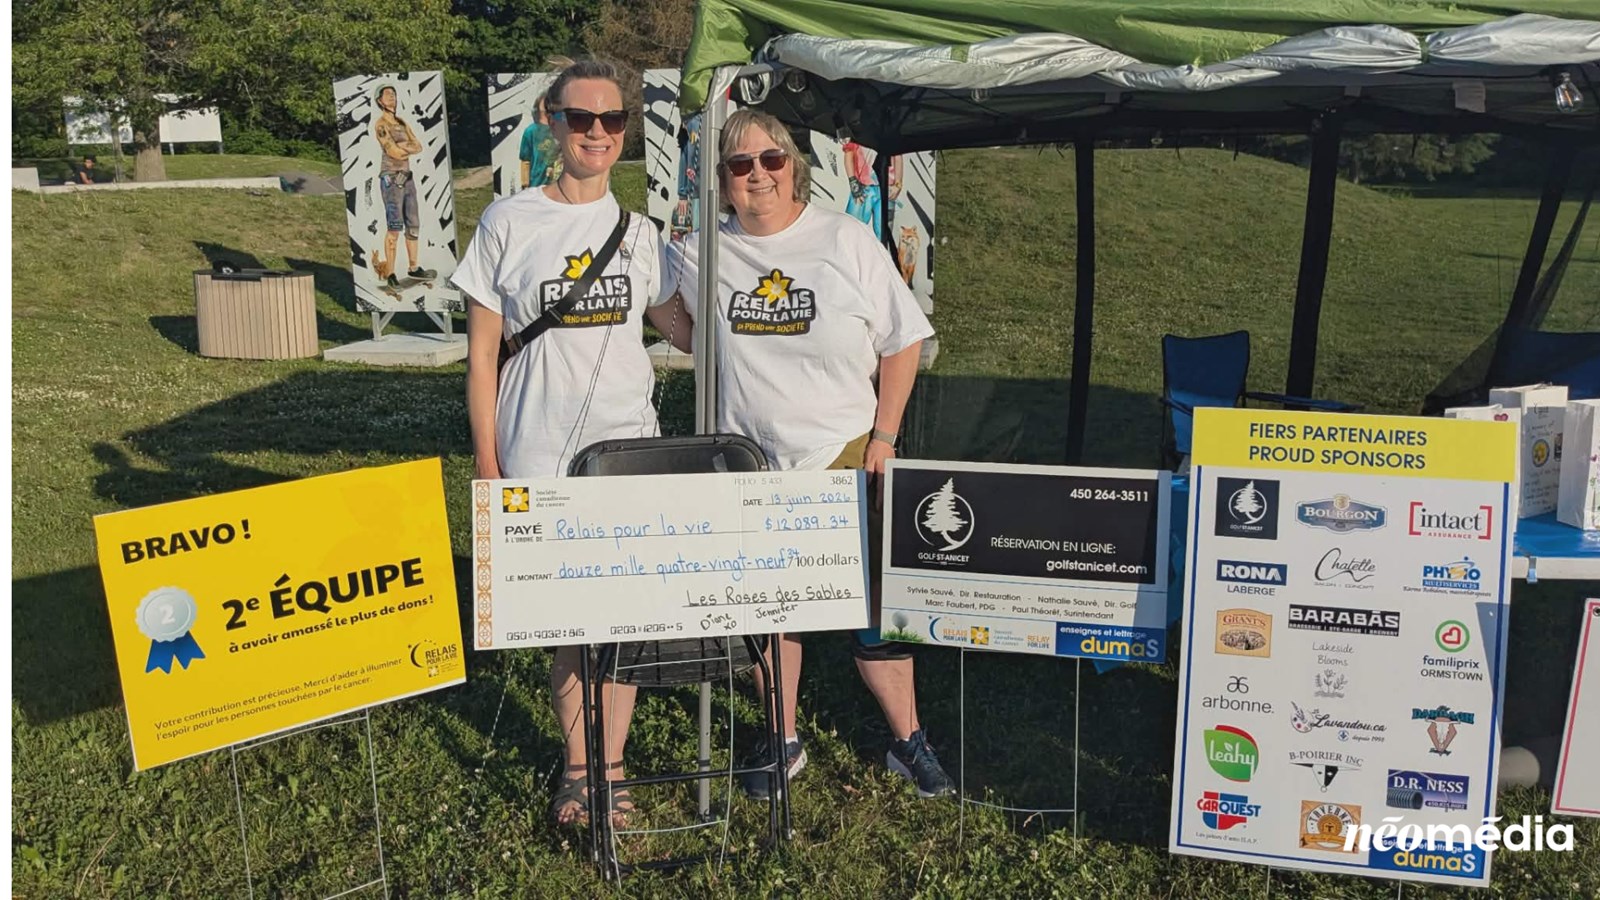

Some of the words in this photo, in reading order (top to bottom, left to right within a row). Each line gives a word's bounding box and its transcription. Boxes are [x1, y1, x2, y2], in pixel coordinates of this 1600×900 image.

[544, 277, 628, 302] REAIS
[733, 291, 811, 312] RELAIS
[732, 310, 770, 321] POUR
[773, 311, 789, 321] LA
[790, 309, 812, 319] VIE
[1250, 423, 1296, 439] FIERS
[1303, 426, 1427, 446] PARTENAIRES
[1250, 446, 1315, 463] PROUD
[1321, 450, 1426, 469] SPONSORS
[830, 476, 853, 485] 3862
[770, 494, 781, 504] 13
[786, 492, 812, 513] juin
[1070, 488, 1092, 500] 450
[1094, 489, 1149, 502] 264-3511
[1304, 507, 1378, 521] BOURGON
[1420, 508, 1482, 531] intact
[505, 522, 543, 535] PAYÉ
[556, 516, 606, 539] Relais
[613, 523, 650, 550] pour
[660, 513, 676, 536] la
[685, 520, 713, 534] vie
[121, 523, 235, 564] BRAVO
[991, 535, 1060, 551] RÉSERVATION
[1063, 541, 1079, 552] EN
[1081, 542, 1116, 554] LIGNE:
[817, 552, 859, 567] dollars
[918, 552, 936, 560] GOLF
[559, 562, 603, 579] douze
[611, 554, 645, 576] mille
[1046, 559, 1148, 574] golfstanicet.com
[1221, 564, 1282, 581] RONA
[517, 573, 553, 582] MONTANT
[270, 557, 424, 619] ÉQUIPE
[687, 589, 717, 607] Les
[726, 586, 767, 605] Roses
[775, 585, 800, 602] des
[806, 583, 851, 600] Sables
[907, 586, 929, 595] Sylvie
[974, 591, 1021, 601] Restauration
[1038, 596, 1071, 604] Nathalie
[1227, 585, 1276, 596] LABERGE
[160, 604, 177, 625] 2
[755, 602, 798, 619] Jennifer
[925, 599, 944, 607] Marc
[946, 601, 977, 610] Faubert,
[979, 603, 996, 611] PDG
[1064, 609, 1114, 619] Surintendant
[229, 642, 239, 653] à
[241, 633, 279, 650] avoir
[281, 618, 333, 640] amassé
[335, 616, 348, 627] le
[350, 610, 378, 625] plus
[380, 604, 395, 616] de
[700, 613, 732, 631] Diane
[1060, 626, 1102, 636] enseignes
[1114, 629, 1147, 639] lettrage
[425, 643, 457, 659] RELAIS
[1312, 642, 1354, 654] Lakeside
[1317, 655, 1348, 667] Blooms
[1423, 655, 1479, 670] familiprix
[1420, 668, 1483, 681] ORMSTOWN
[154, 717, 183, 730] Votre
[184, 700, 242, 722] contribution
[242, 697, 256, 706] est
[258, 686, 303, 703] précieuse.
[303, 677, 329, 689] Merci
[330, 669, 359, 682] d'aider
[366, 658, 402, 673] illuminer
[156, 726, 191, 741] l'espoir
[192, 719, 214, 731] pour
[216, 715, 230, 724] les
[230, 703, 277, 721] personnes
[277, 691, 317, 707] touchées
[318, 688, 333, 697] par
[334, 682, 343, 691] le
[343, 677, 373, 689] cancer.
[1202, 695, 1274, 714] arbonne.
[1311, 714, 1387, 732] Lavandou.ca
[1210, 739, 1255, 782] leahy
[1345, 755, 1363, 767] INC
[1394, 776, 1422, 790] D.R.
[1427, 779, 1464, 793] NESS
[1197, 798, 1261, 817] CARQUEST
